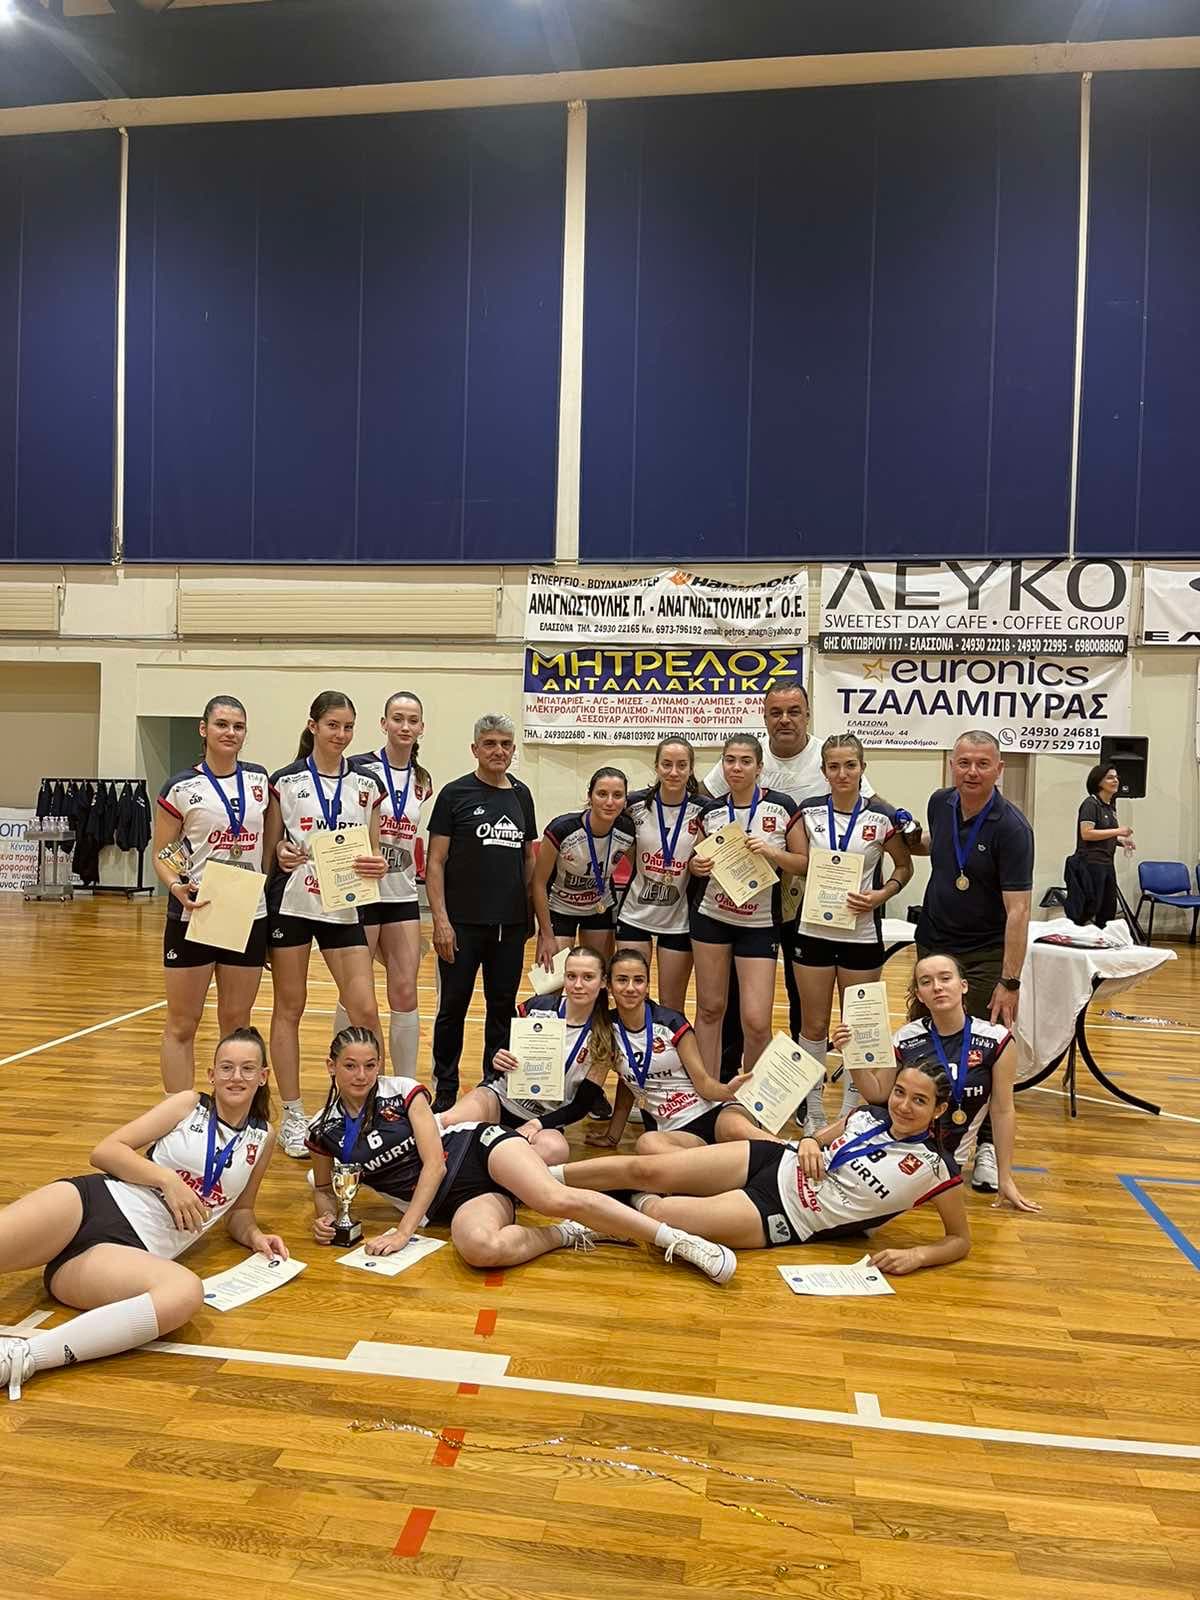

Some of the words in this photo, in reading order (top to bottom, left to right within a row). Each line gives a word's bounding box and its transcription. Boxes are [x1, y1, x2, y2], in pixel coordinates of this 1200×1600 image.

[531, 573, 579, 588] ΣΥΝΕΡΓΕΙΟ
[825, 559, 1127, 612] ΛΕΥΚΟ
[528, 593, 630, 617] ΑΝΑΓΝΩΣΤΟΥΛΗΣ
[634, 595, 645, 617] Π.
[657, 595, 761, 619] ΑΝΑΓΝΩΣΤΟΥΛΗΣ
[765, 597, 776, 618] Σ.
[618, 624, 640, 634] 22165
[824, 613, 903, 629] SWEETEST
[907, 615, 941, 629] DAY
[945, 615, 988, 629] CAFE
[1003, 615, 1062, 630] COFFEE
[1067, 616, 1125, 631] GROUP
[841, 637, 887, 651] ΟΚΤΩΒΡΙΟΥ
[889, 638, 903, 651] 117
[910, 637, 954, 651] ΕΛΑΣΣΟΝΑ
[961, 638, 985, 651] 24930
[987, 638, 1010, 651] 22218
[1017, 638, 1041, 651] 24930
[1043, 639, 1067, 652] 22995
[532, 650, 798, 677] ΜΗΤΡΕΛΟΣ
[891, 655, 1089, 687] euronics
[536, 696, 584, 705] ΜΠΑΤΑΡΙΕΣ
[617, 697, 643, 705] ΜΙΖΕΣ
[651, 697, 688, 705] ΔΥΝΑΜΟ
[697, 697, 735, 706] ΛΑΜΠΕΣ
[837, 688, 1108, 719] ΤΖΑΛΑΜΠΥΡΑΣ
[598, 705, 648, 714] ΕΞΟΠΛΙΣΜΟ
[656, 706, 705, 715] ΛΙΠΑΝΤΙΚΑ
[714, 706, 749, 715] ΦΙΛΤΡΑ
[575, 715, 621, 724] ΑΞΕΣΟΥΑΡ
[623, 715, 684, 724] ΑΥΤΟΚΙΝΗΤΩΝ
[693, 715, 743, 724] ΦΟΡΤΗΓΩΝ
[1020, 726, 1059, 738] 24930
[1063, 727, 1100, 738] 24681
[1019, 739, 1049, 749] 6977
[1052, 740, 1075, 750] 529
[1078, 740, 1100, 750] 710
[316, 820, 363, 831] WRT
[624, 1069, 672, 1083] WRTH
[366, 1129, 383, 1150] 6
[850, 1158, 890, 1200] ÜRTH
